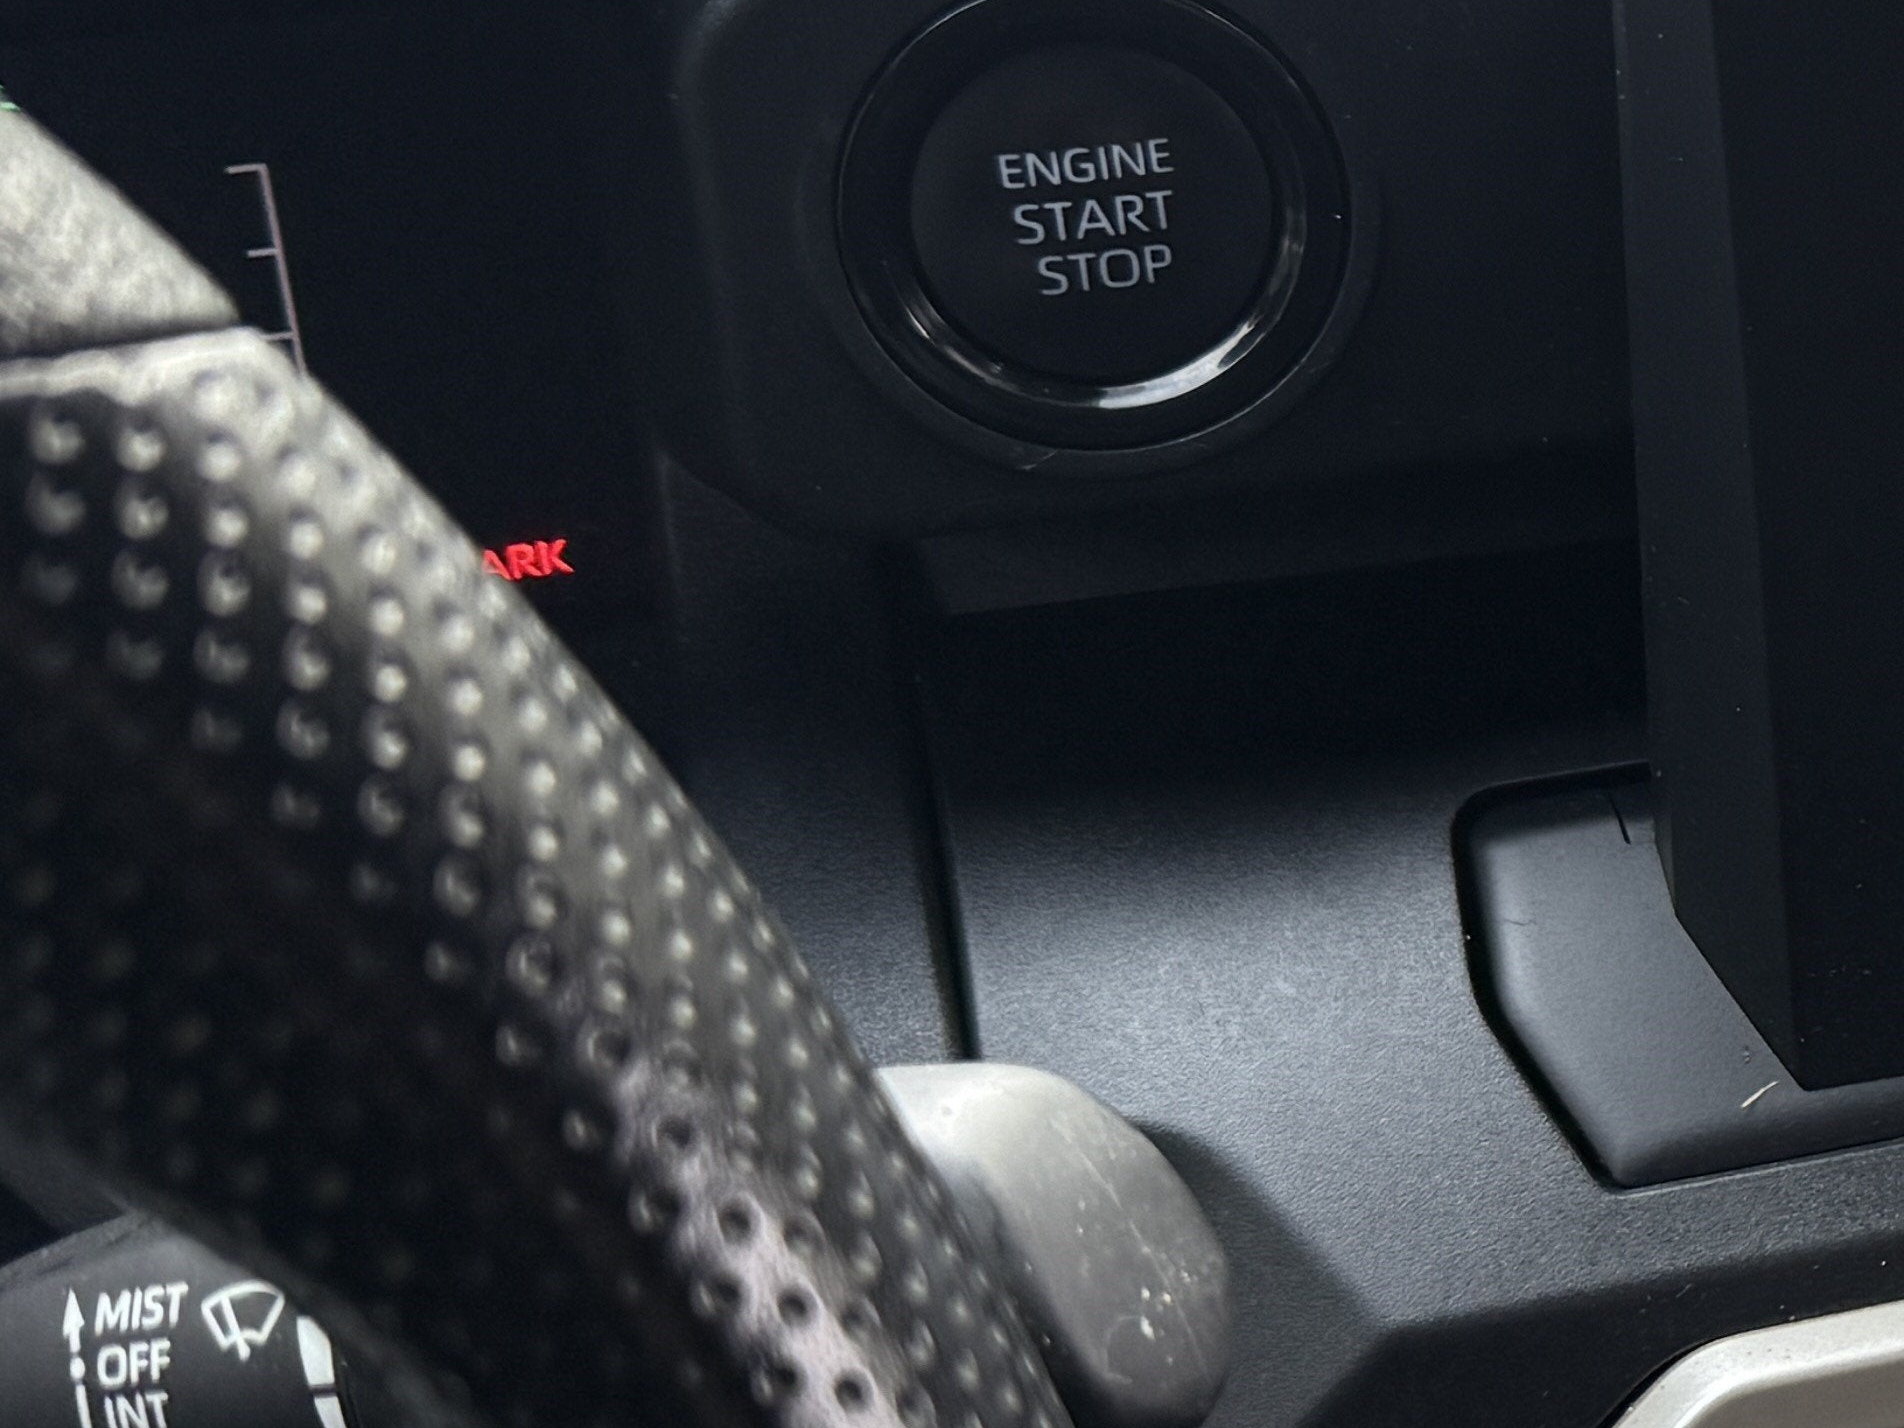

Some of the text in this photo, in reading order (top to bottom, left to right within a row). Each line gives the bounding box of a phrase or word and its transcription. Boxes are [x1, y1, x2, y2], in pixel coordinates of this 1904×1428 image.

[997, 137, 1174, 191] ENGINE
[1011, 189, 1173, 247] START
[1036, 243, 1173, 297] STOP
[94, 1280, 189, 1336] MIST
[96, 1337, 172, 1389] OFF
